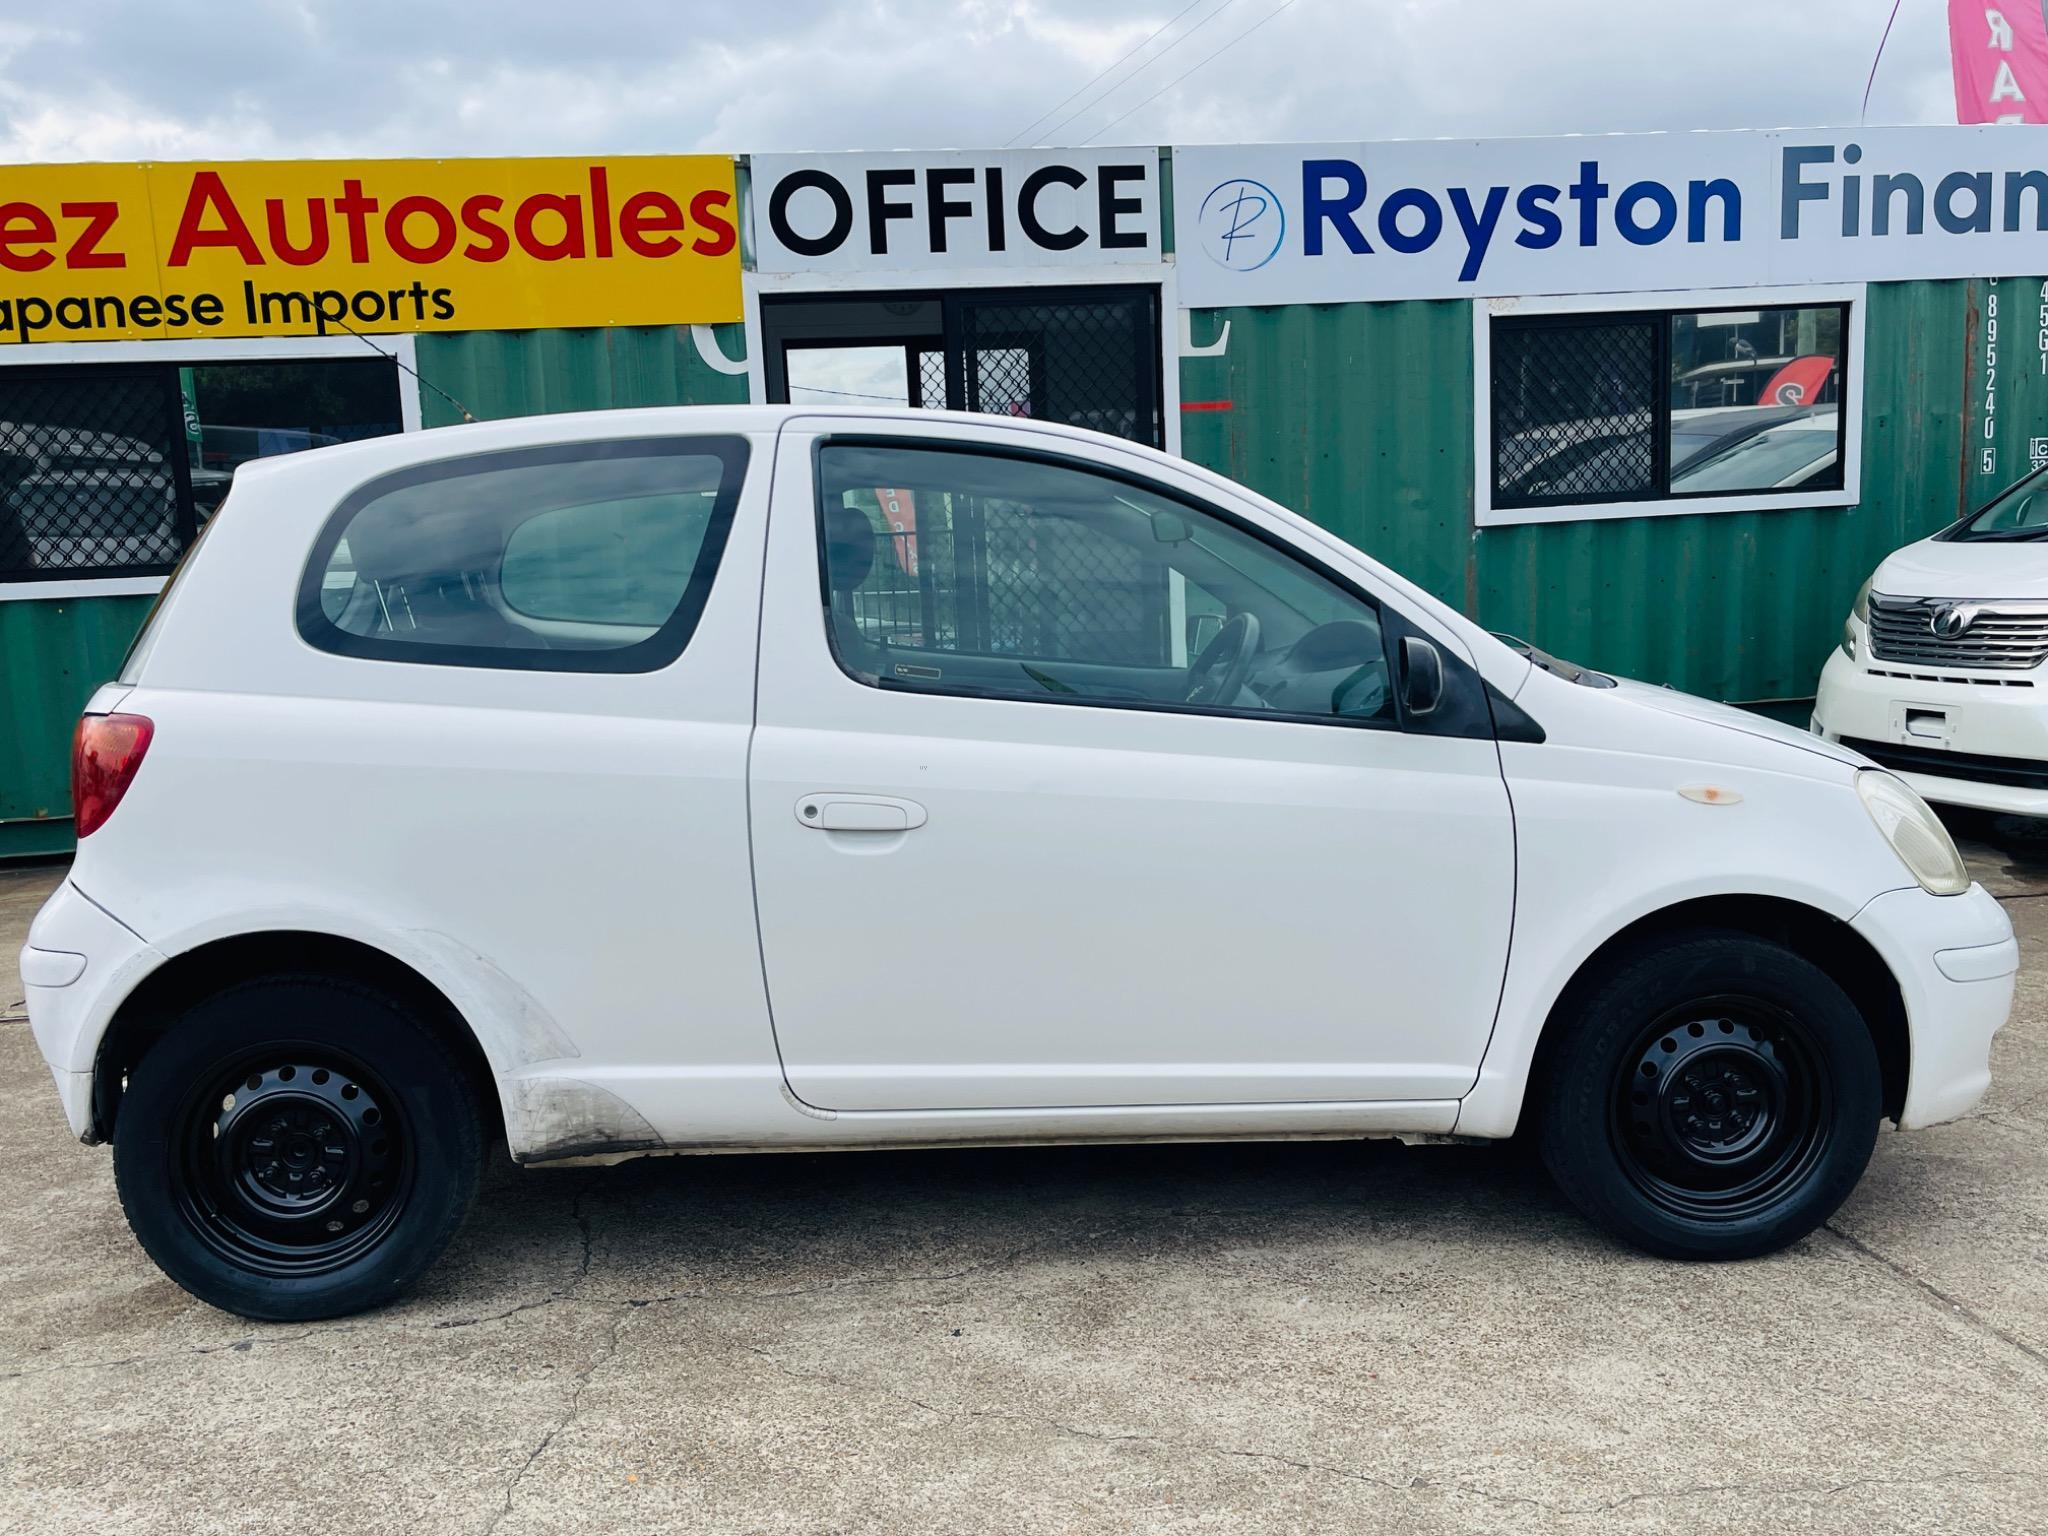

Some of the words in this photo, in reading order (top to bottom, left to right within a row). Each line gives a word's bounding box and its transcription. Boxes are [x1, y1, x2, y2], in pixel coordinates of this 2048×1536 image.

[168, 166, 736, 267] Autosales
[769, 165, 1148, 257] OFFICE
[1302, 159, 1741, 282] Royston
[1780, 143, 2048, 239] Finan
[244, 280, 456, 338] Imports
